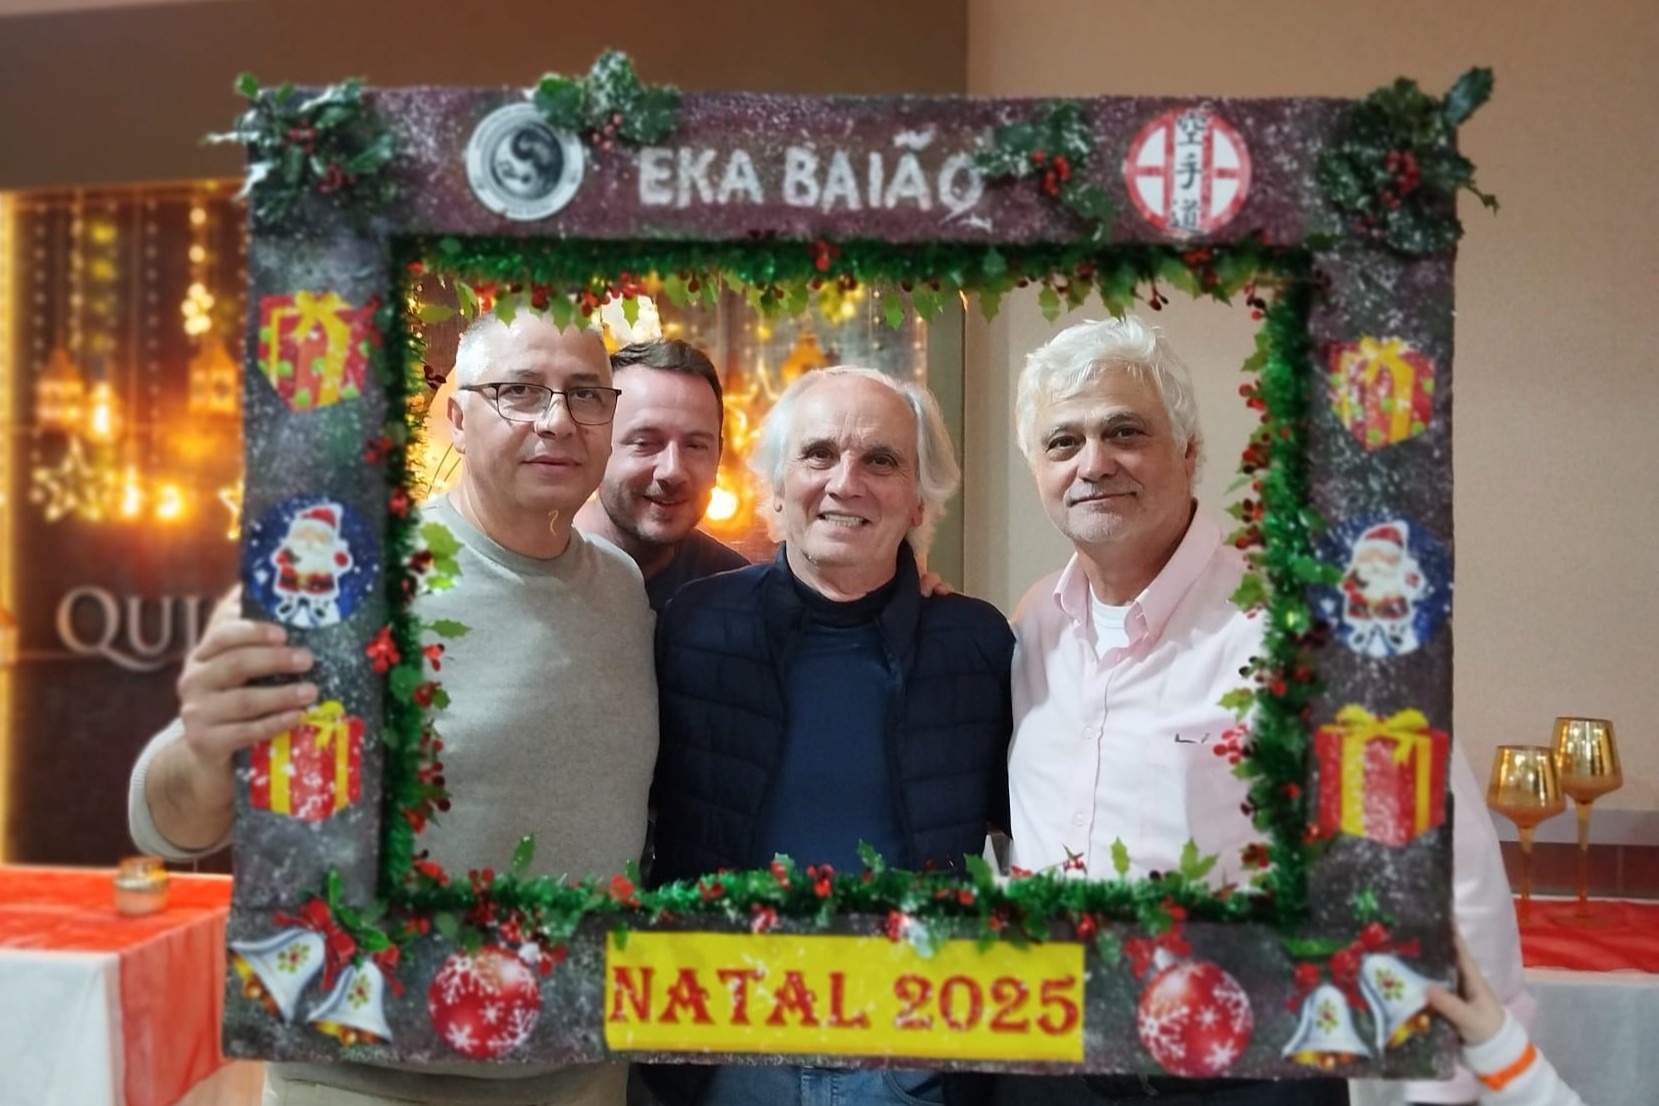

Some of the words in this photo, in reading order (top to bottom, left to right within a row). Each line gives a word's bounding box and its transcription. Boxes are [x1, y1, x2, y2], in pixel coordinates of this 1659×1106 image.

[637, 146, 764, 209] EKA
[782, 125, 986, 214] BAIÃO
[1168, 111, 1204, 235] 空手道
[607, 966, 872, 1029] NATAL
[893, 973, 1080, 1037] 2025
